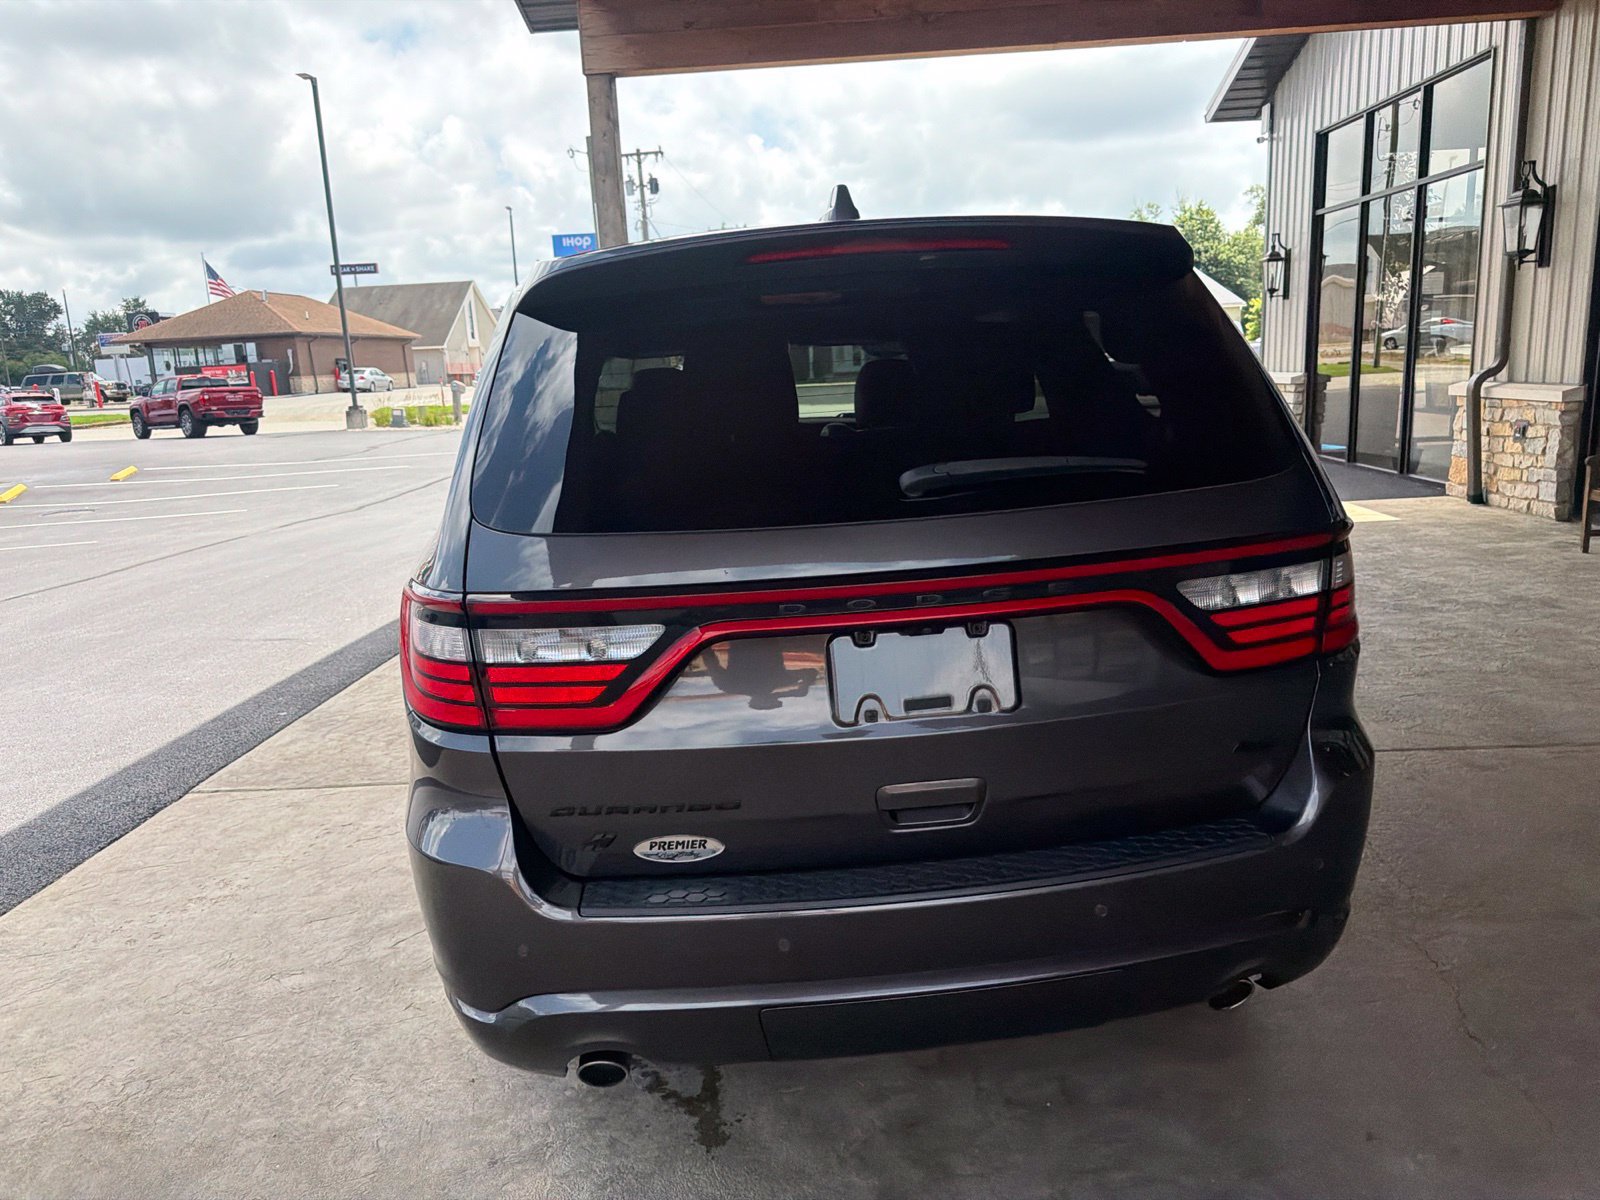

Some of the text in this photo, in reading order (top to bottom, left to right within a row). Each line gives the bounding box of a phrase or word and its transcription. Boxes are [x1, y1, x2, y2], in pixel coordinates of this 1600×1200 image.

[778, 582, 1068, 615] DODGE
[549, 800, 742, 817] DURANGO
[649, 839, 708, 851] PREMIER
